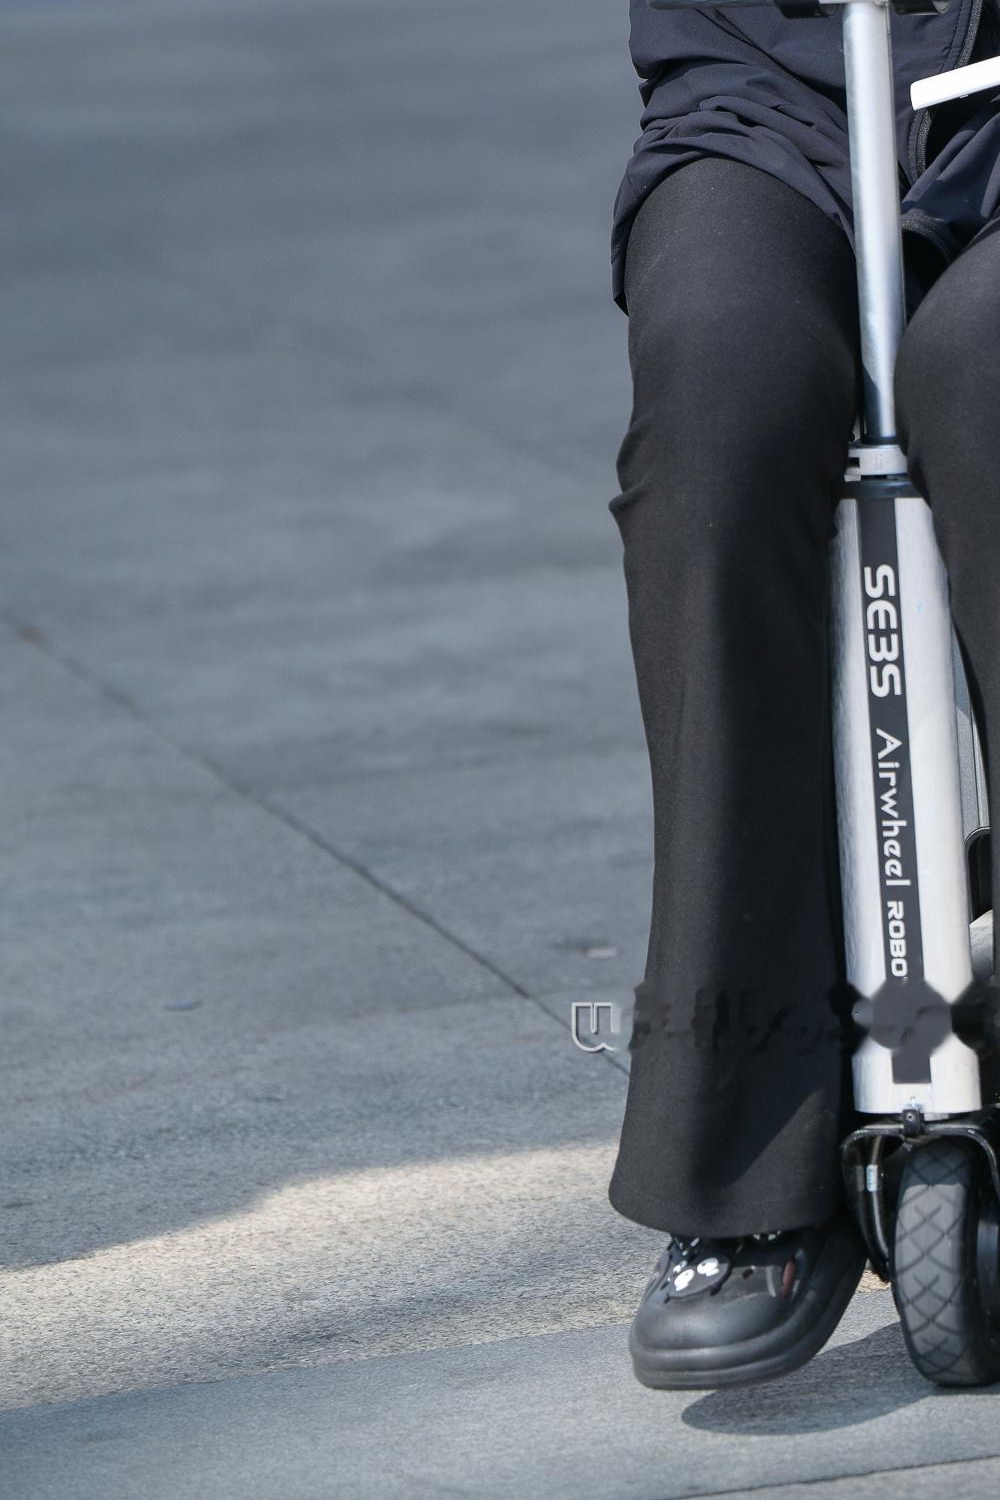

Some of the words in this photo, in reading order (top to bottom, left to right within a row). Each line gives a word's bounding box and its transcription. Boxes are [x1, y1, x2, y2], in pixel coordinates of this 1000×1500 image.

[864, 564, 902, 698] SE3S
[876, 727, 911, 886] Airwheel
[887, 900, 908, 979] ROBO
